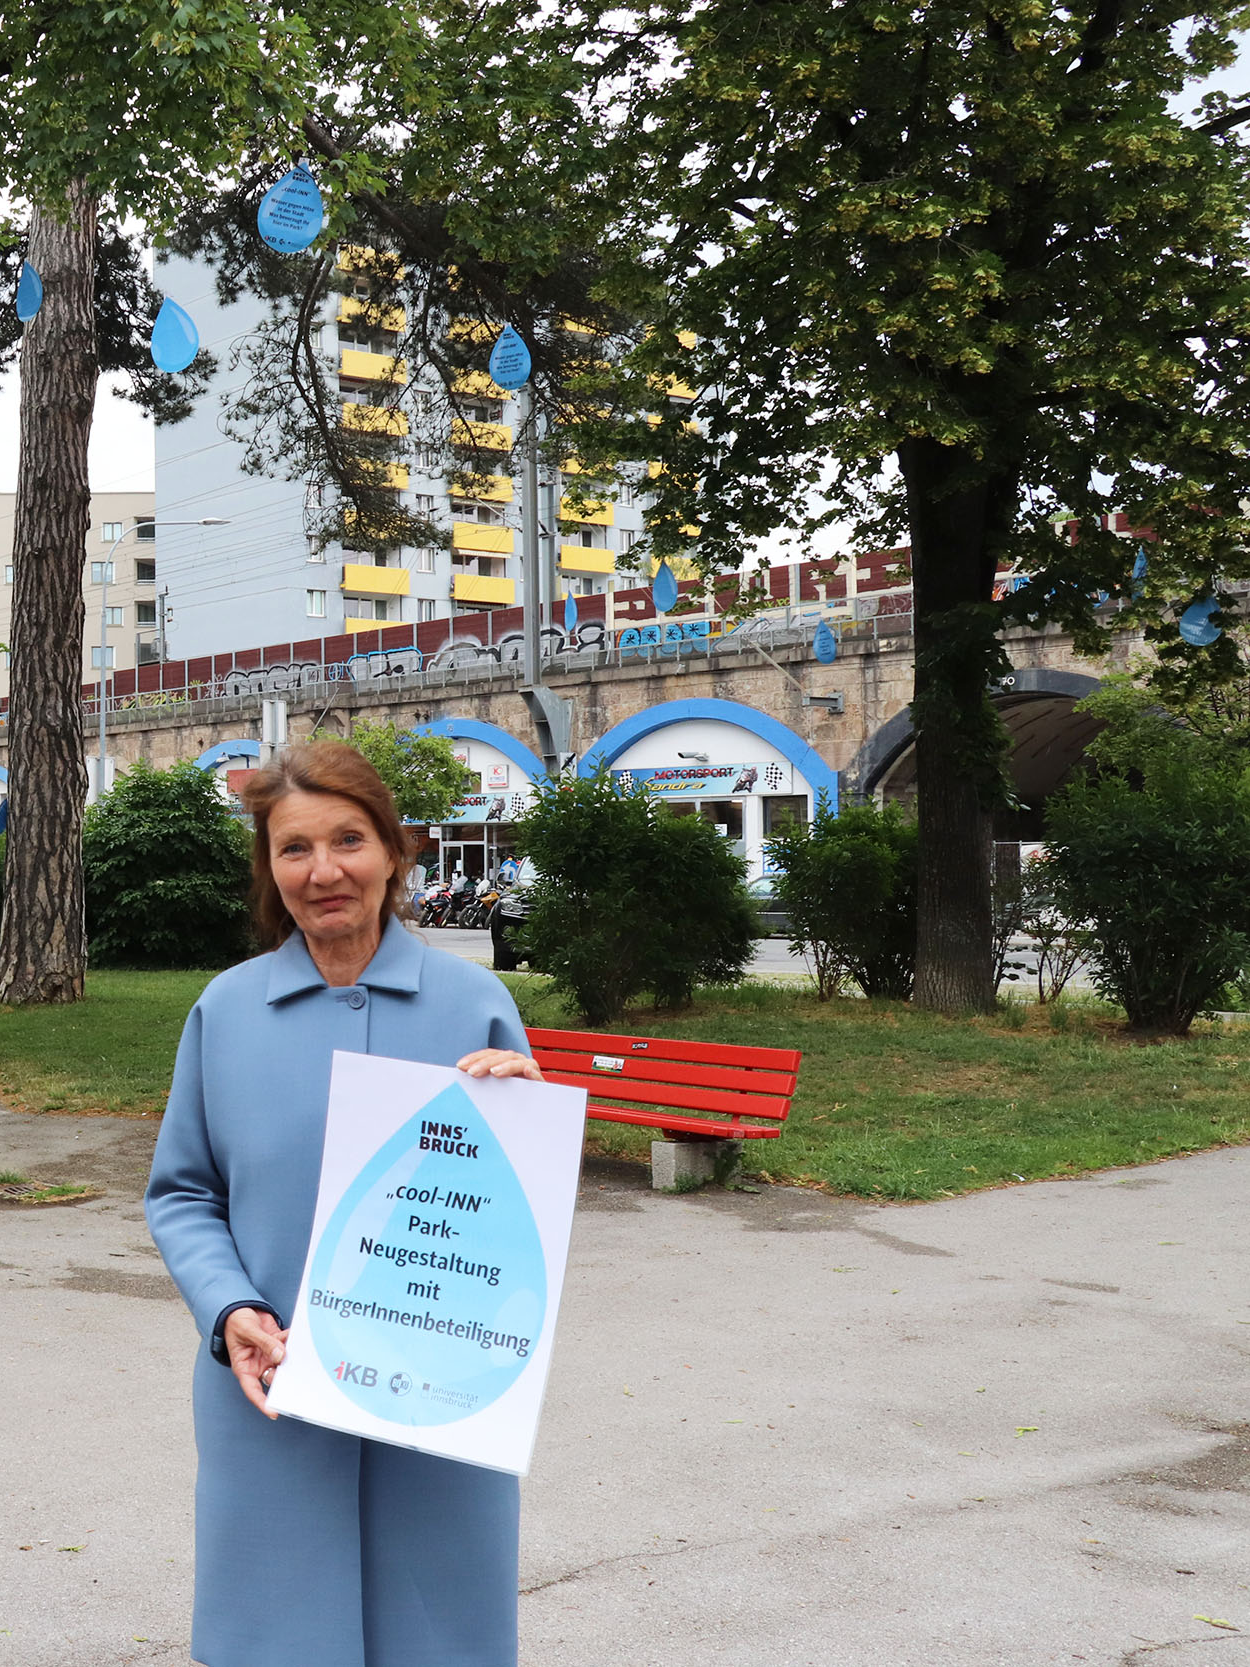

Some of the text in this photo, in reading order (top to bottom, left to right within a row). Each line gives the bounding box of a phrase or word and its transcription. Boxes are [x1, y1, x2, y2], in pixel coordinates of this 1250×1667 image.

[654, 769, 733, 780] MOTORSPORT
[419, 1136, 479, 1159] BRUCK
[408, 1216, 460, 1239] Park-
[360, 1237, 502, 1285] Neugestaltung
[407, 1280, 441, 1301] mit
[309, 1288, 531, 1357] BürgerInnenbeteiligung
[430, 1394, 472, 1409] innsbruck
[433, 1387, 478, 1402] universität
